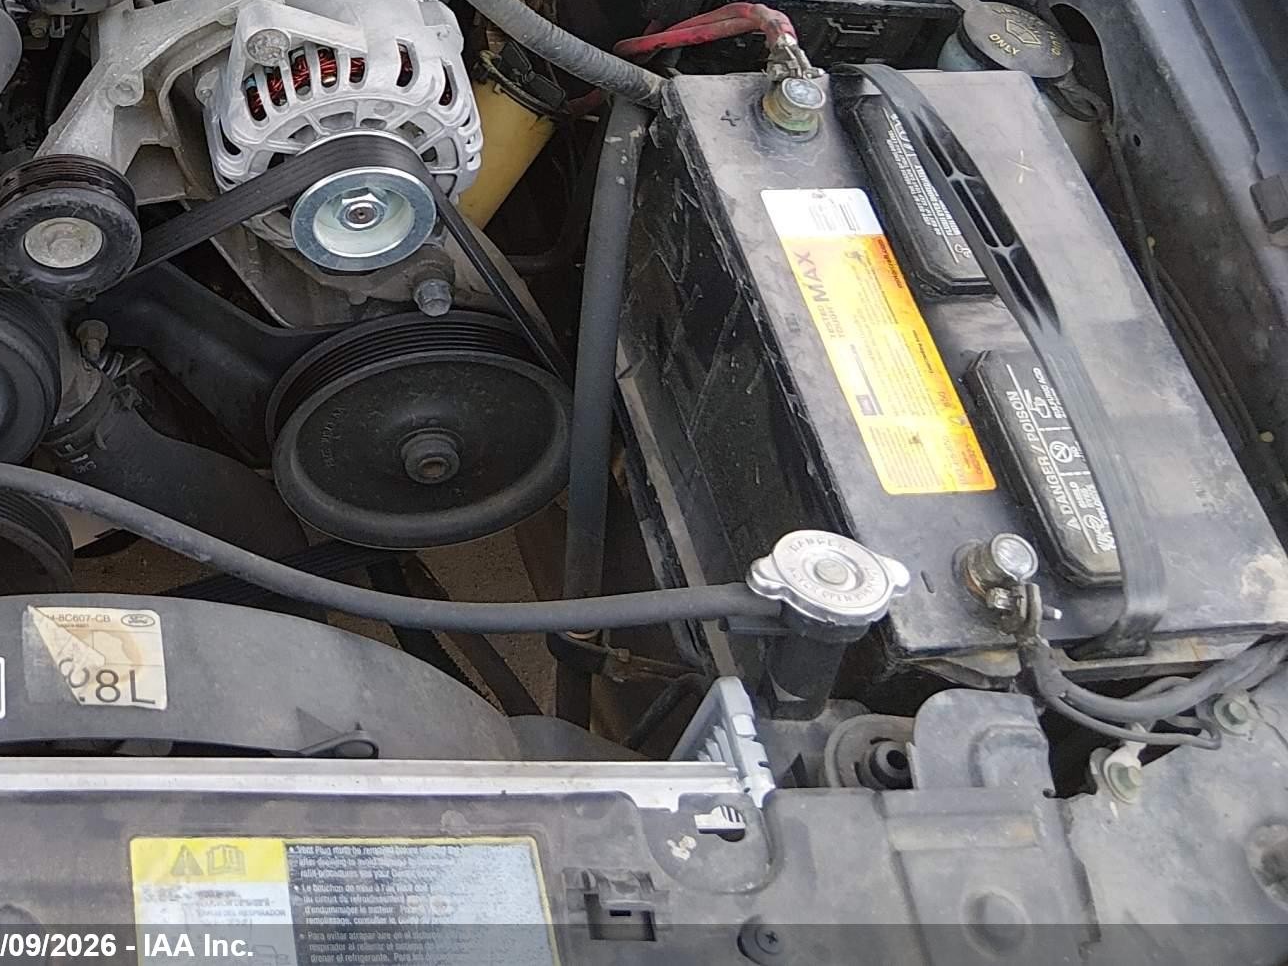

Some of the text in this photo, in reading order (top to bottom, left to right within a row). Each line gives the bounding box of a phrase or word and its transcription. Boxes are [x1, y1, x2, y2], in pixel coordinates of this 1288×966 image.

[989, 33, 1021, 55] ONLY
[792, 250, 837, 339] TESTED MAX
[1006, 388, 1039, 442] POISON
[1036, 454, 1073, 515] DANGER
